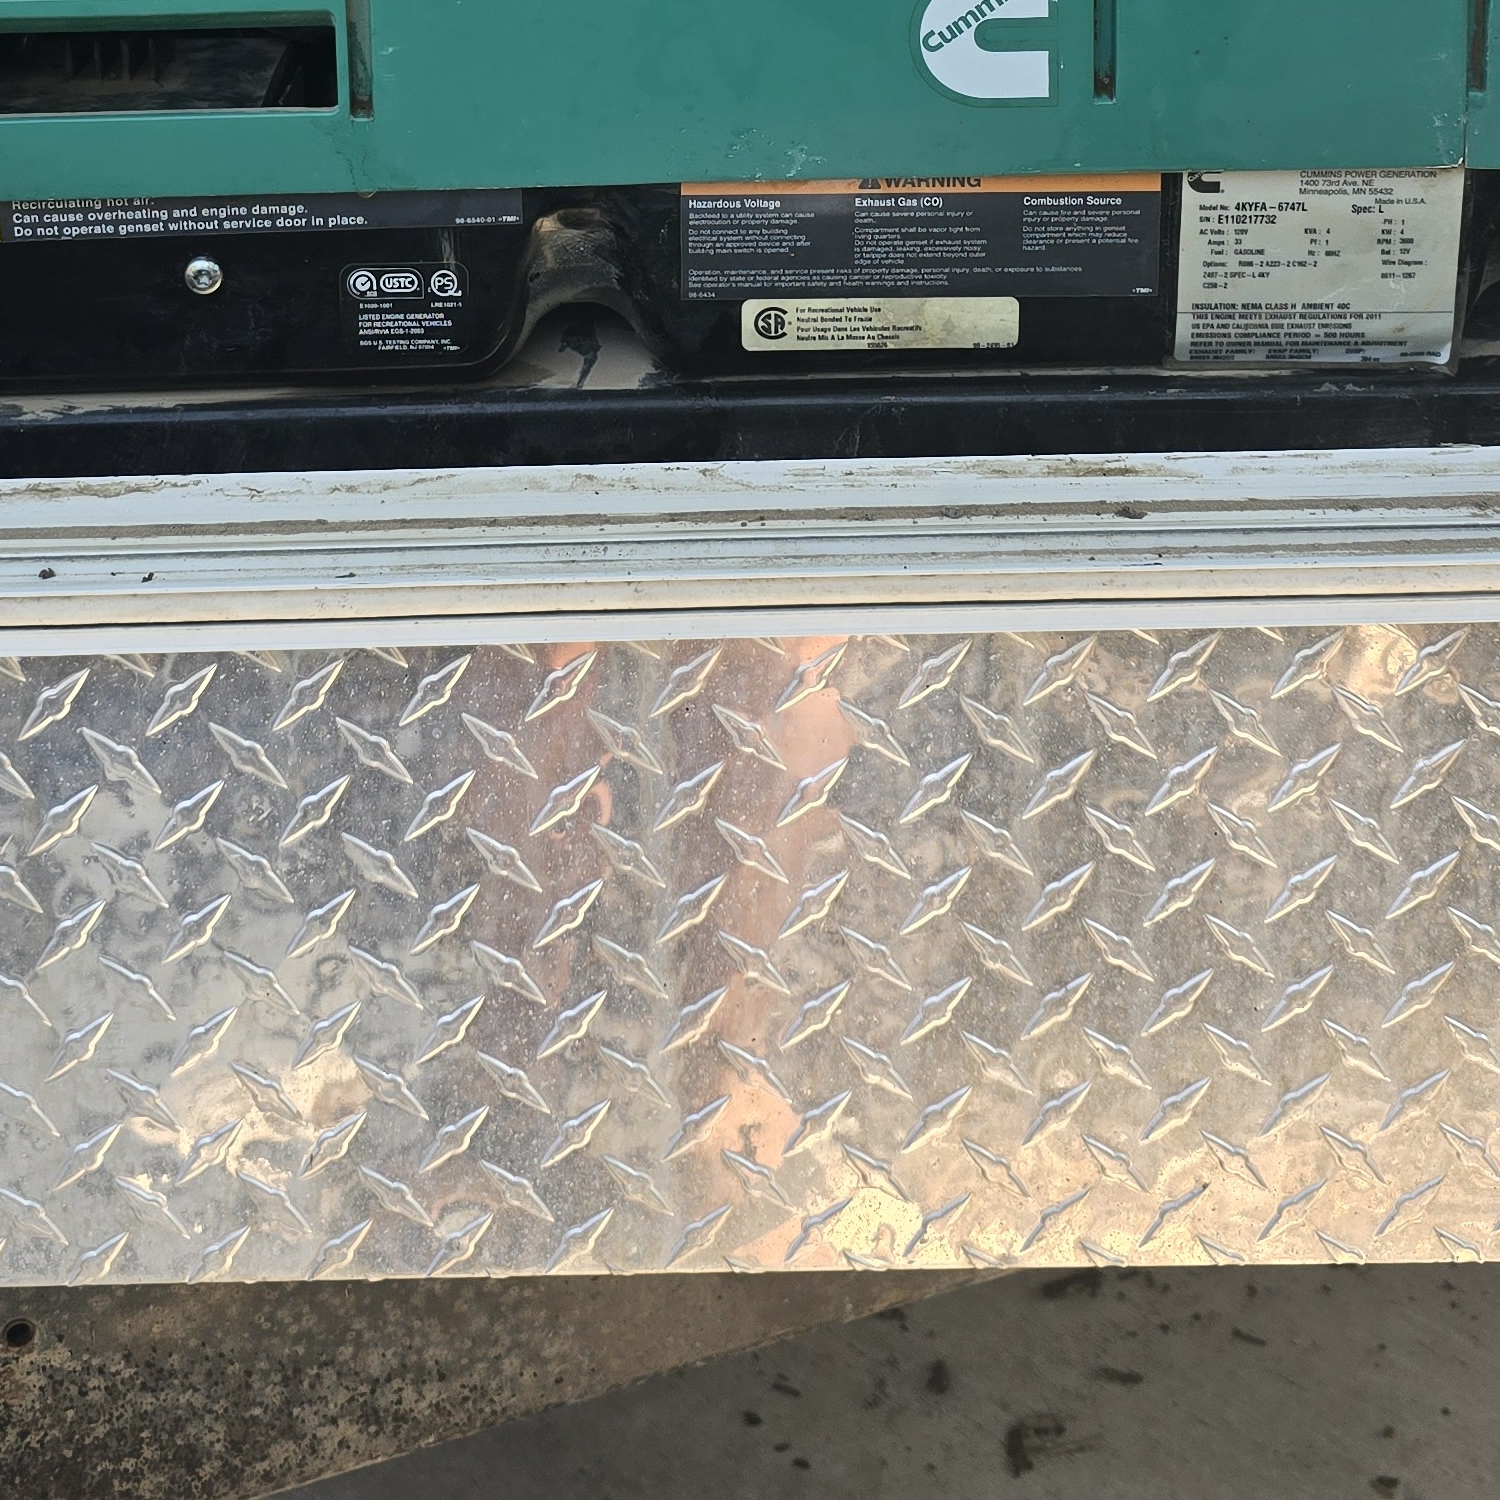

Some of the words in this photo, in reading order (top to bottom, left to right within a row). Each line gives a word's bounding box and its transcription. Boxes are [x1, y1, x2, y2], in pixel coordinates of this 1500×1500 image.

[1300, 170, 1343, 179] CUMMINS
[1344, 170, 1378, 179] POWER
[1379, 170, 1437, 179] GENERATION
[1299, 179, 1320, 187] 1400
[1321, 179, 1340, 187] 73rd
[1342, 179, 1360, 187] Ave.
[1361, 179, 1375, 187] NE
[1298, 187, 1350, 197] Minneapolis,
[1352, 187, 1367, 196] MN
[1368, 187, 1394, 196] 55432
[688, 198, 742, 210] Hazardous
[744, 198, 782, 210] Voltage
[854, 197, 896, 207] Exhaust
[897, 197, 918, 207] Gas
[920, 196, 944, 208] (CO)
[1023, 196, 1084, 206] Combustion
[1086, 196, 1123, 206] Source
[1374, 197, 1395, 205] Made
[1396, 197, 1404, 205] in
[12, 210, 40, 224] Can
[42, 211, 84, 223] cause
[87, 207, 169, 222] overheating
[172, 206, 198, 219] and
[201, 205, 249, 219] engine
[251, 203, 309, 217] damage.
[1351, 204, 1376, 215] Spec:
[1377, 204, 1385, 214] L
[1217, 214, 1278, 225] E110217732
[13, 225, 33, 238] Do
[36, 224, 60, 236] not
[63, 223, 115, 238] operate
[119, 222, 165, 236] genset
[168, 218, 220, 232] without
[223, 217, 273, 230] service
[275, 215, 308, 228] door
[311, 215, 325, 227] in
[328, 214, 369, 228] place.
[384, 277, 413, 289] USTC
[1191, 302, 1239, 311] INSULATION:
[1241, 302, 1263, 311] NEMA
[1265, 302, 1289, 311] CLASS
[1301, 302, 1334, 311] AMBIENT
